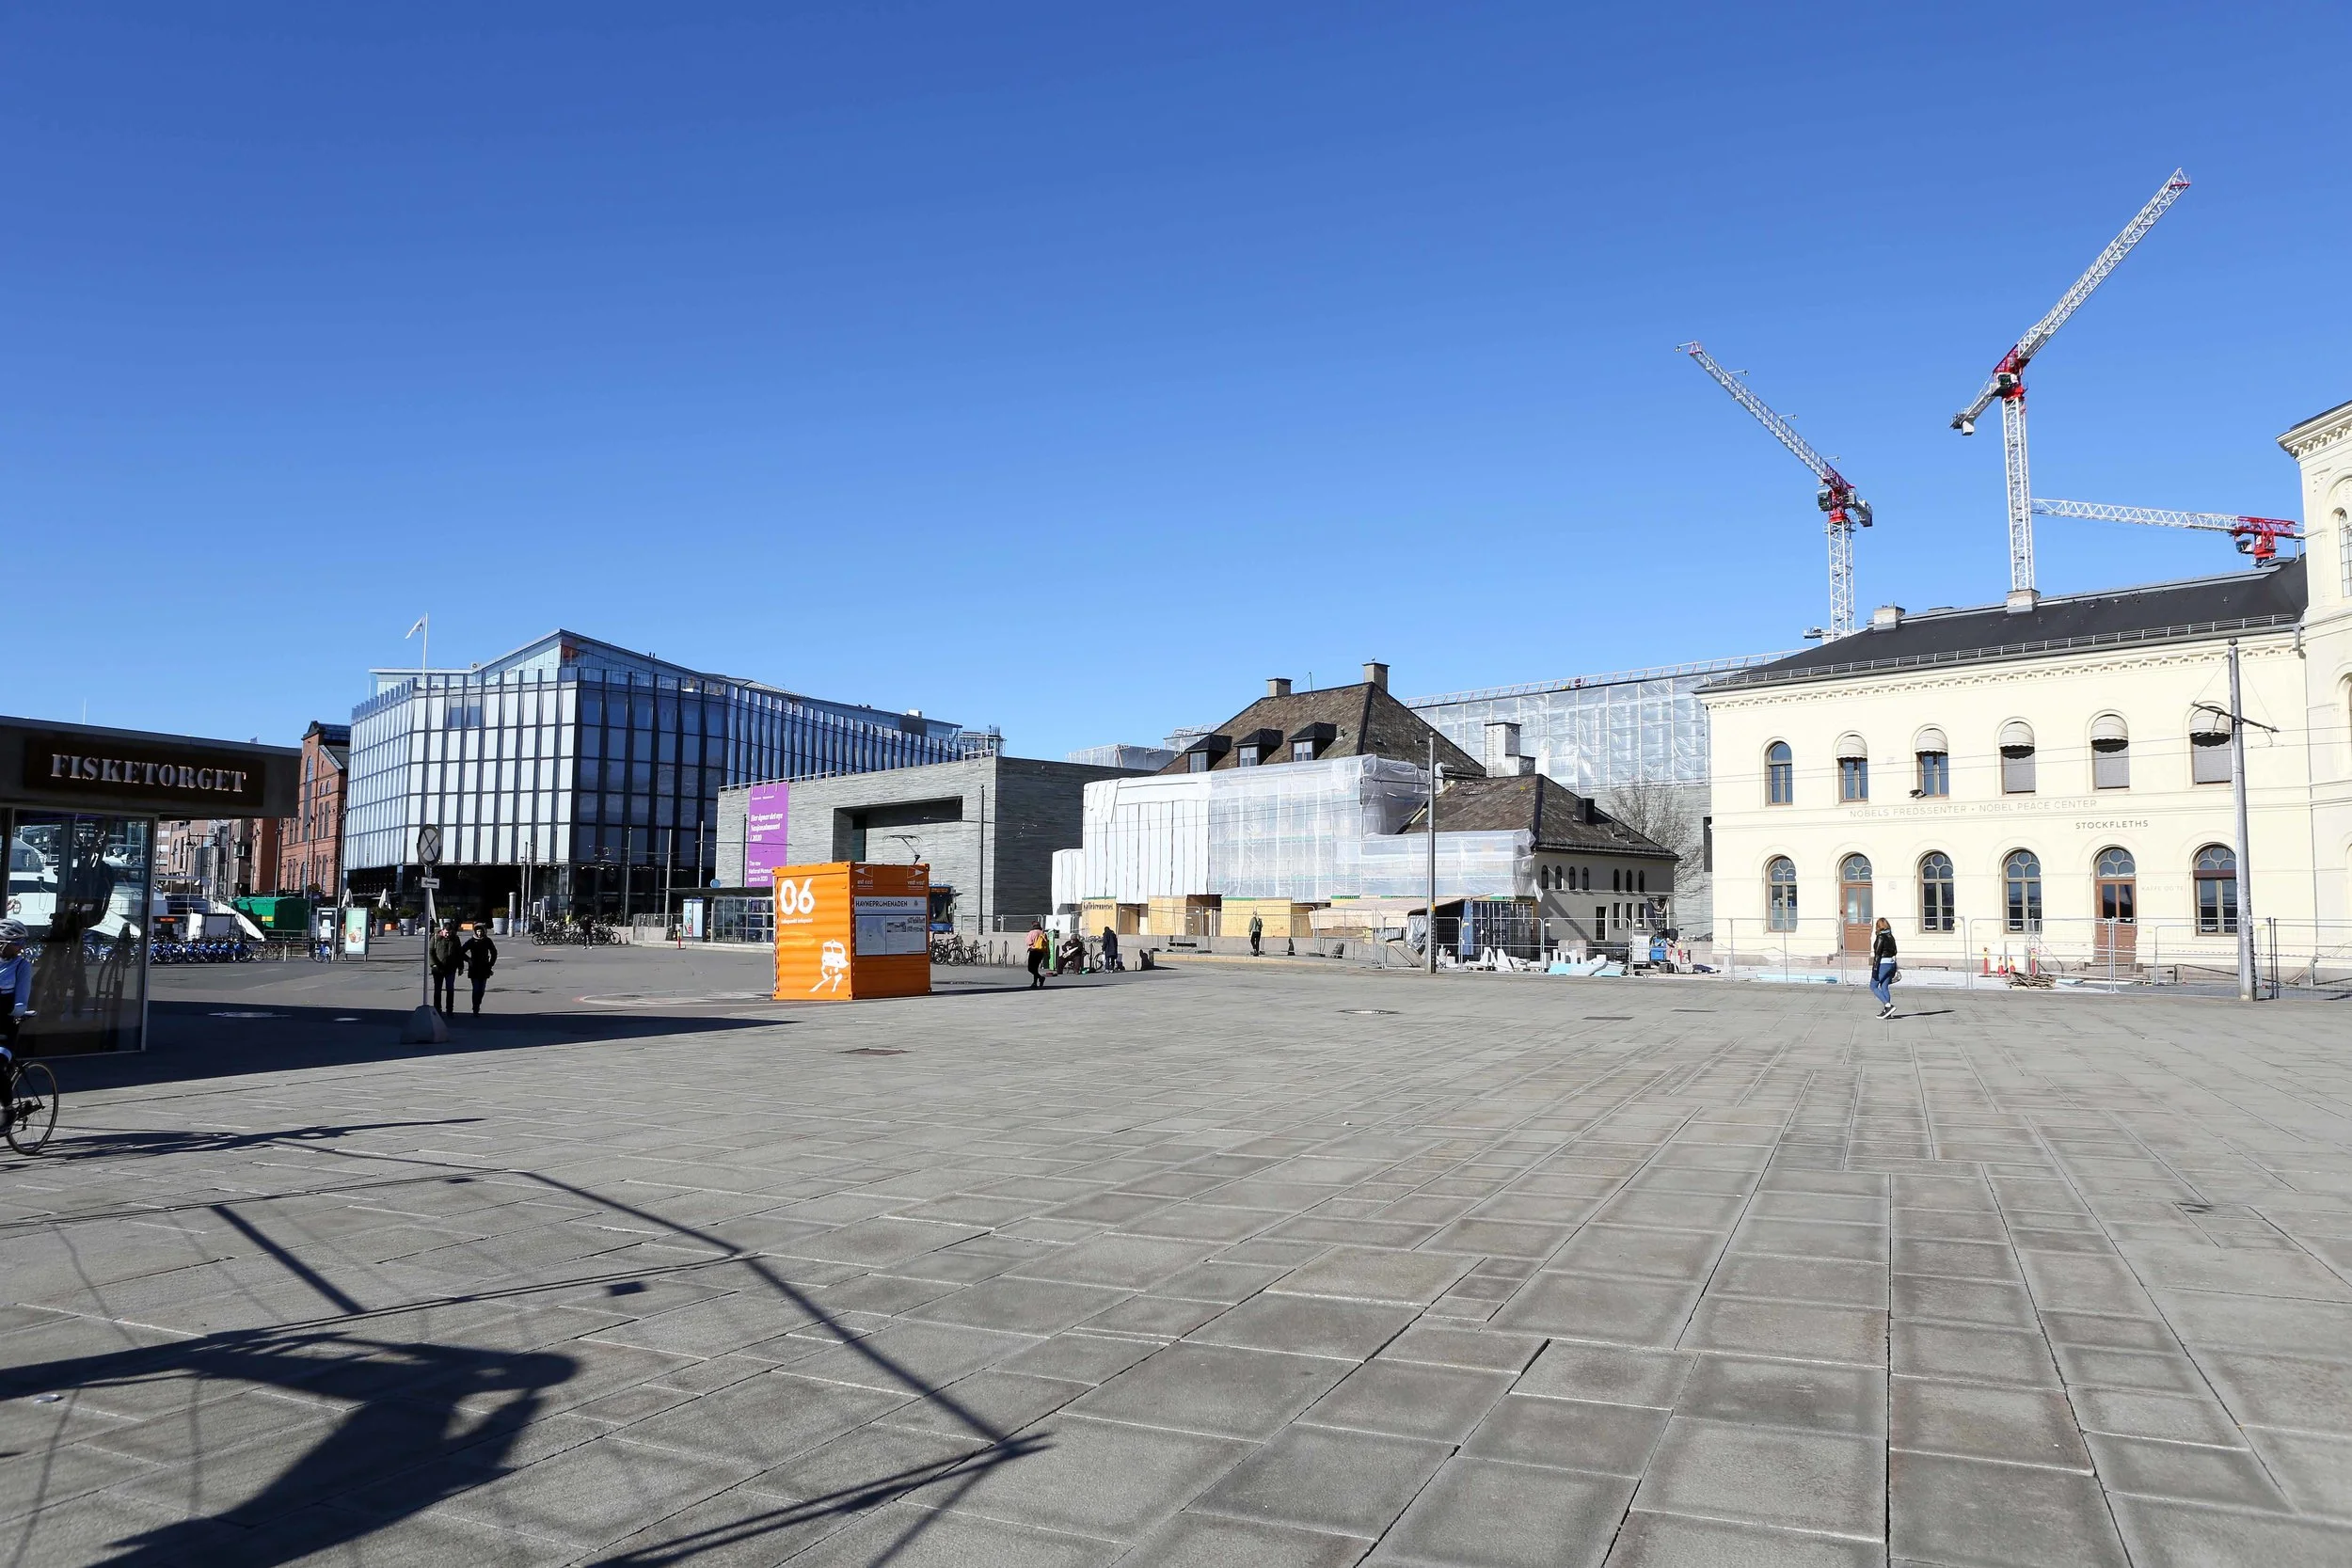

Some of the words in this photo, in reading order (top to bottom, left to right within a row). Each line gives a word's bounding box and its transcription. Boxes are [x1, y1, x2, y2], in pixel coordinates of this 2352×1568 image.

[51, 753, 247, 793] FISKETORGET
[1850, 808, 1889, 817] NOBELS
[1893, 805, 1967, 816] FREDSSENTER
[1979, 803, 2013, 813] NOBEL
[2017, 801, 2050, 811] PEACE
[2054, 800, 2098, 809] CENTER
[2075, 819, 2149, 830] STOCKFLETHS
[780, 878, 816, 915] 06
